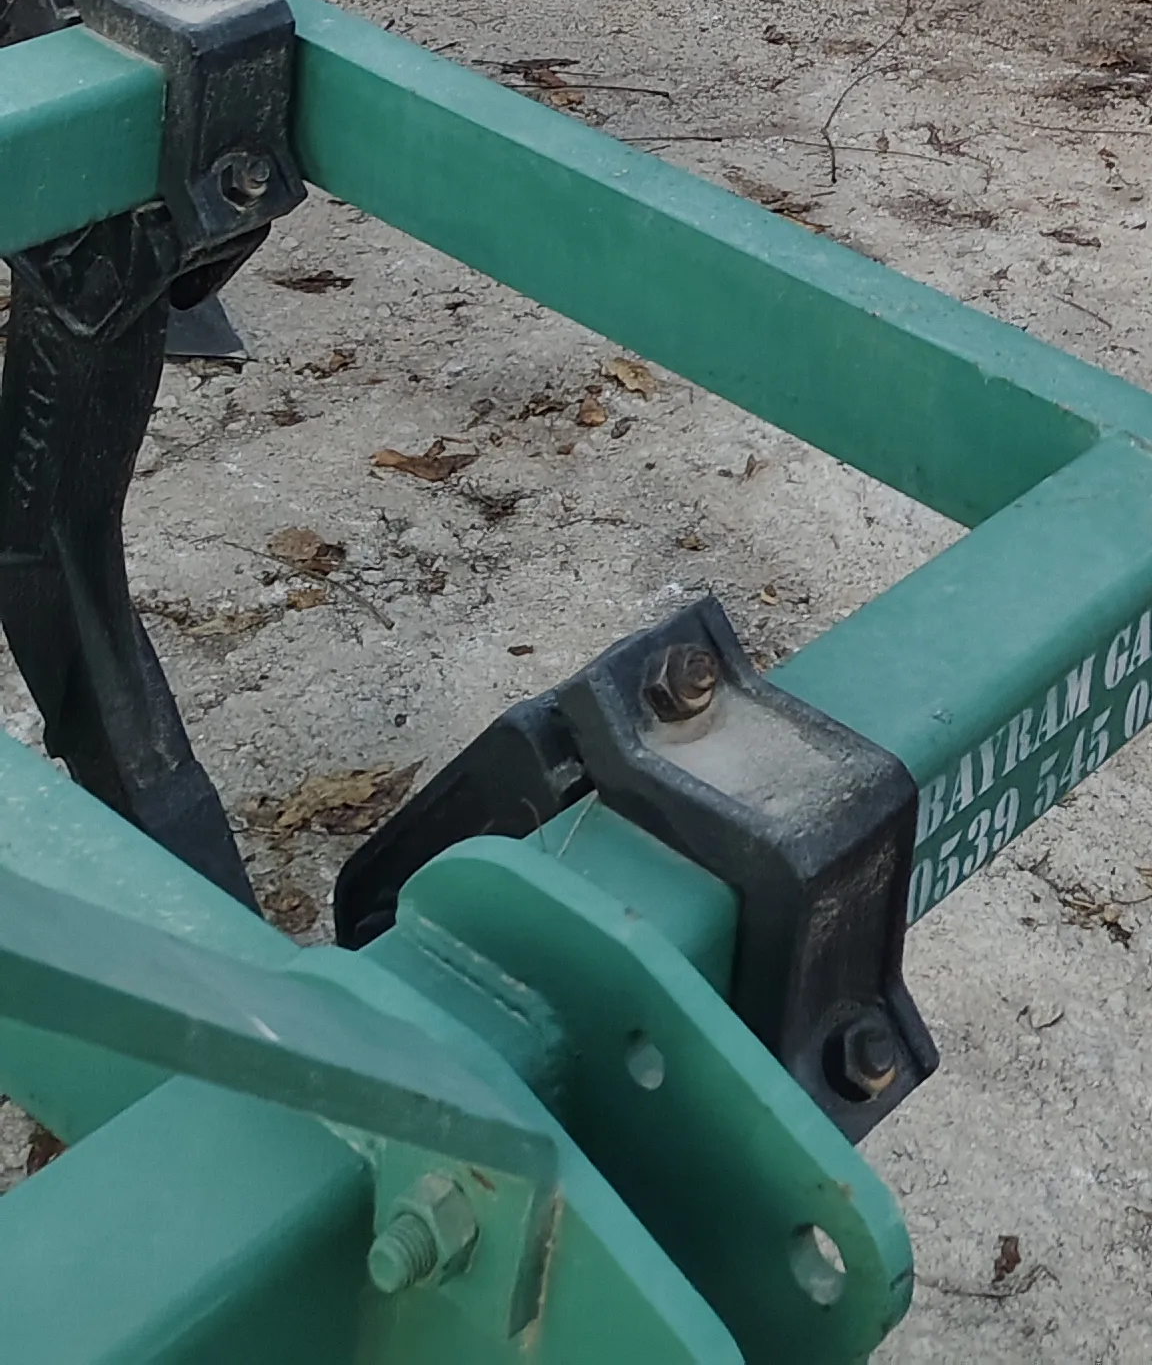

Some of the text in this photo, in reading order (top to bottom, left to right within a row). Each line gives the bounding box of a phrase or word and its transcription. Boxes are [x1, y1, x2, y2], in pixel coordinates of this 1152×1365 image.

[905, 786, 1021, 926] 0539
[1033, 706, 1112, 816] 545
[914, 654, 1096, 848] BAYRAM
